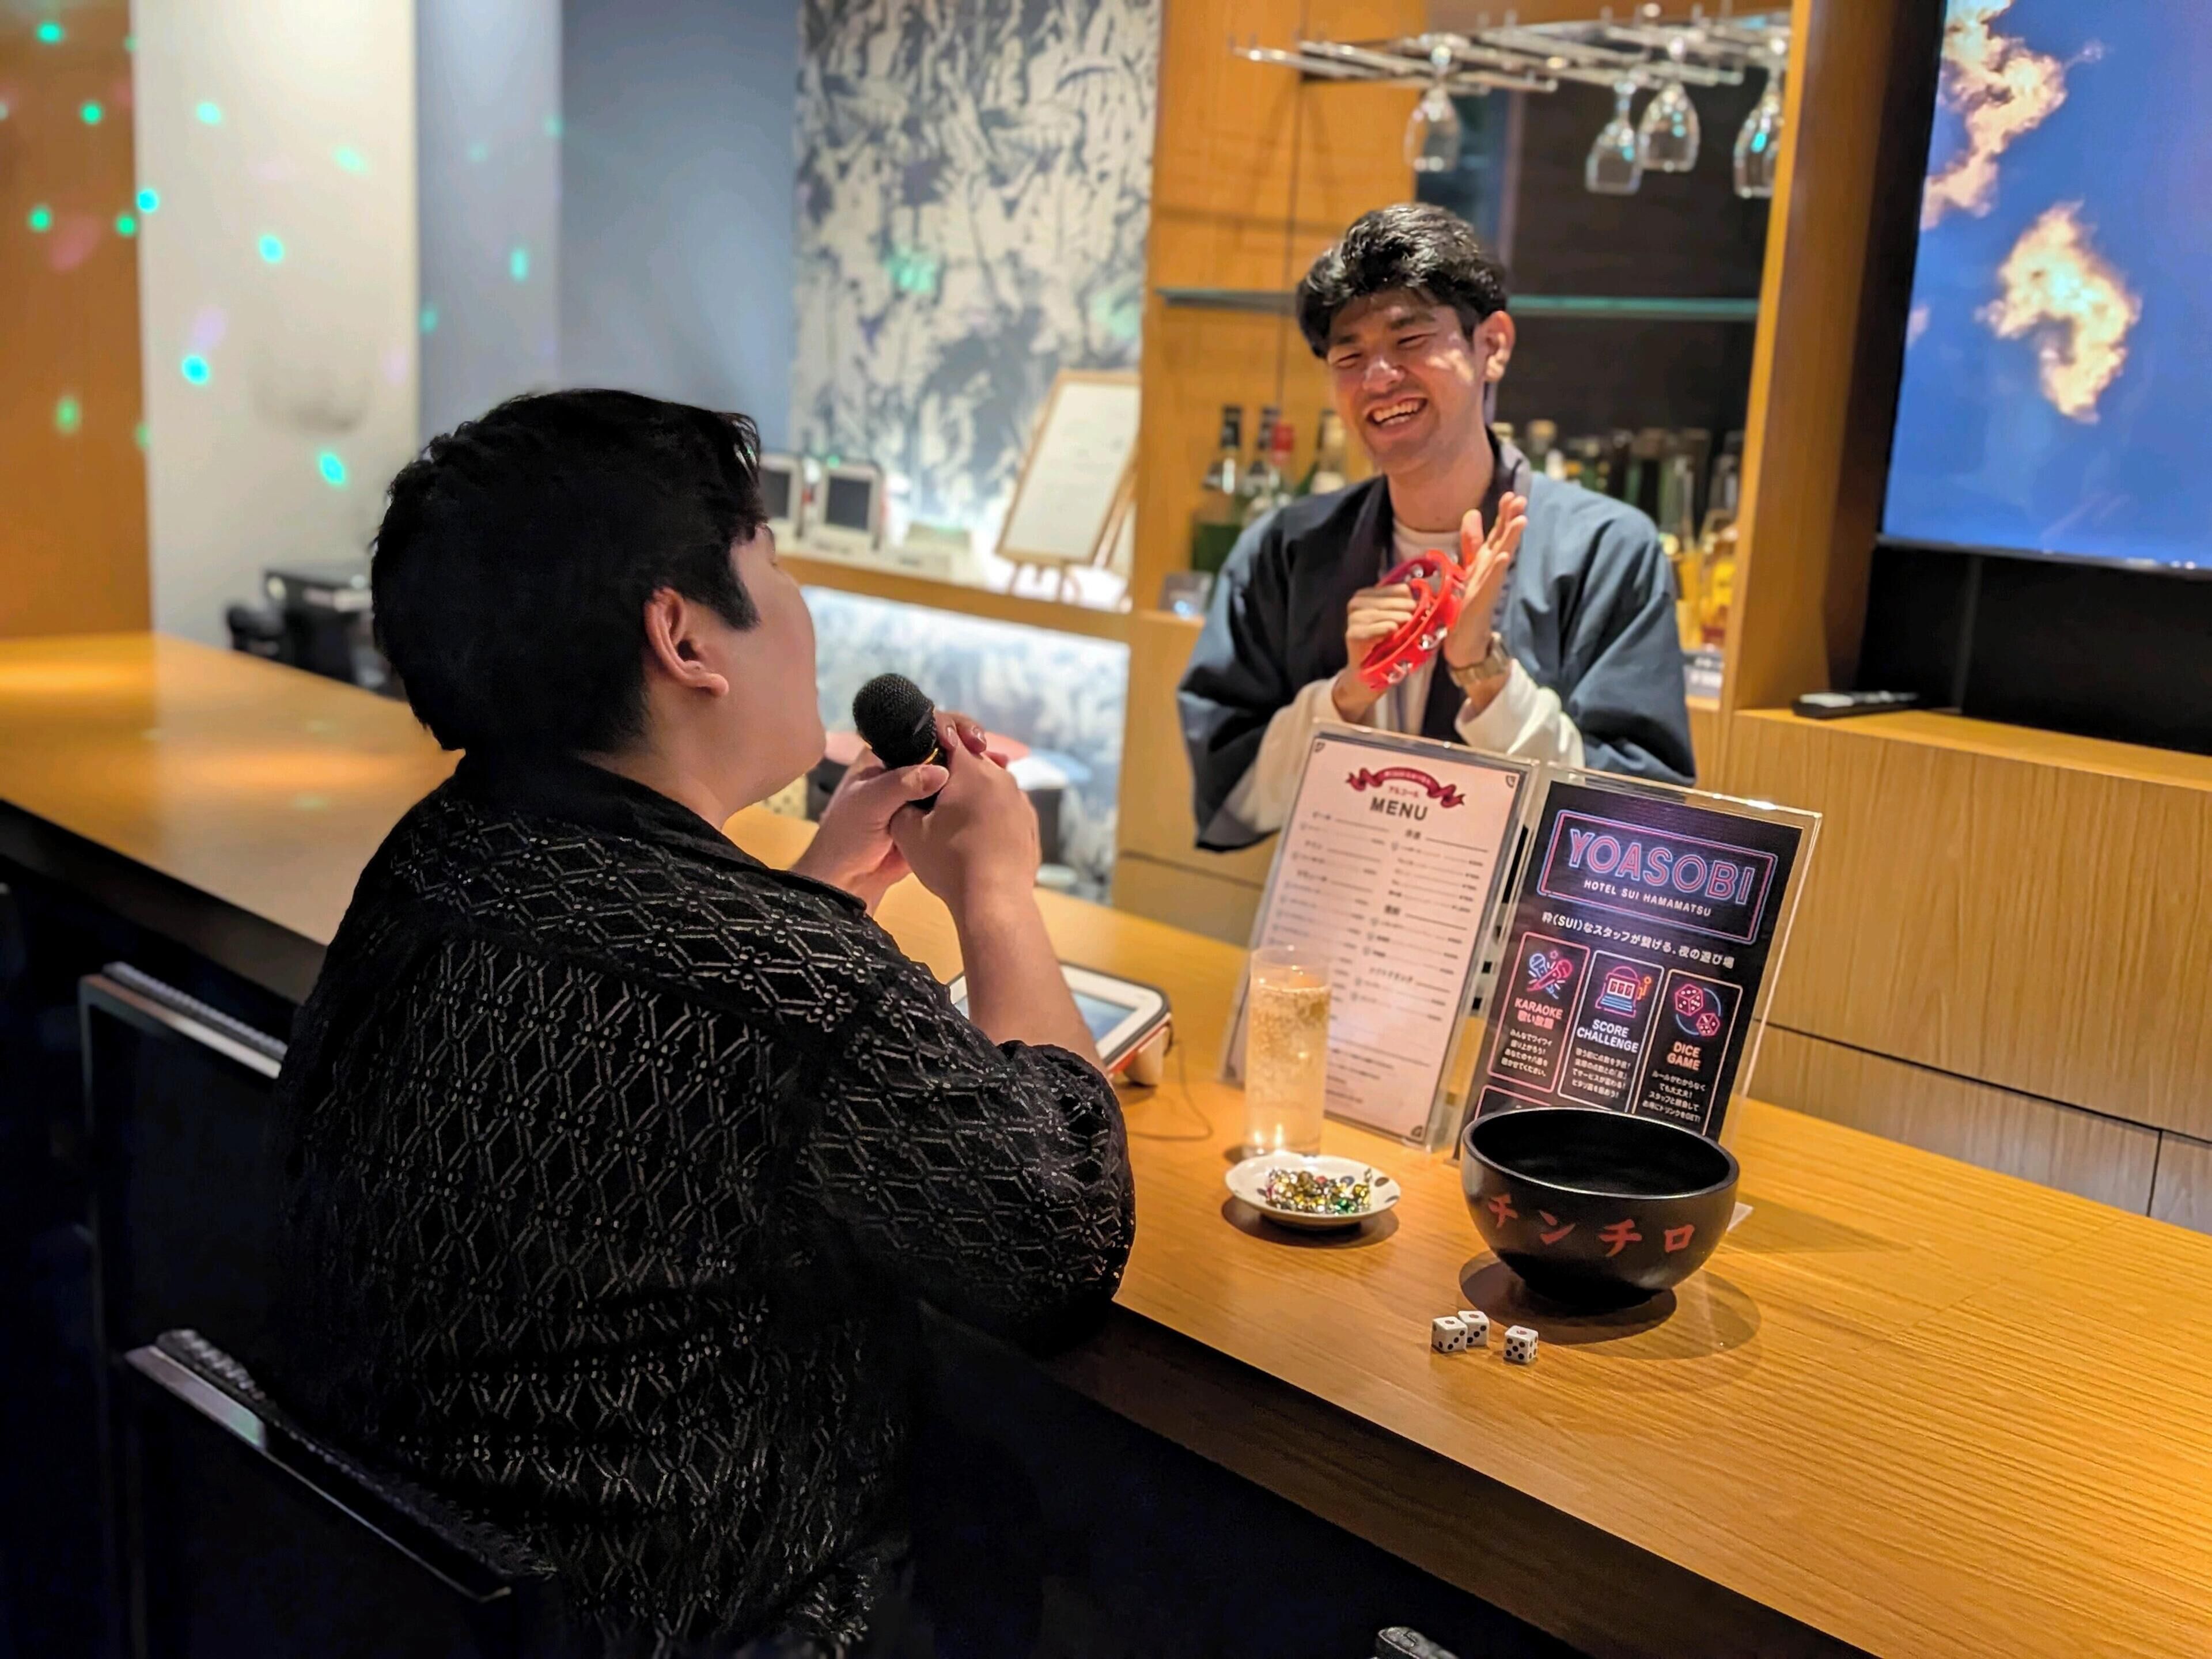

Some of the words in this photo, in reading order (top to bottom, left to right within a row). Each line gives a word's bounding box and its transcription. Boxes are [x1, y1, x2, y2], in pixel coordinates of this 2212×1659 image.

[1370, 797, 1428, 821] MENU
[1569, 828, 1755, 906] YOASOBI
[1584, 880, 1616, 895] HOTEL
[1622, 888, 1639, 900] SUI
[1643, 893, 1711, 917] HAMAMATSU
[1514, 997, 1563, 1020] KARAOKE
[1577, 1027, 1639, 1053] CHALLENGE
[1592, 1019, 1630, 1038] SCORE
[1673, 1041, 1701, 1058] DICE
[1667, 1053, 1701, 1071] GAME
[1488, 1194, 1695, 1257] チンチロ
